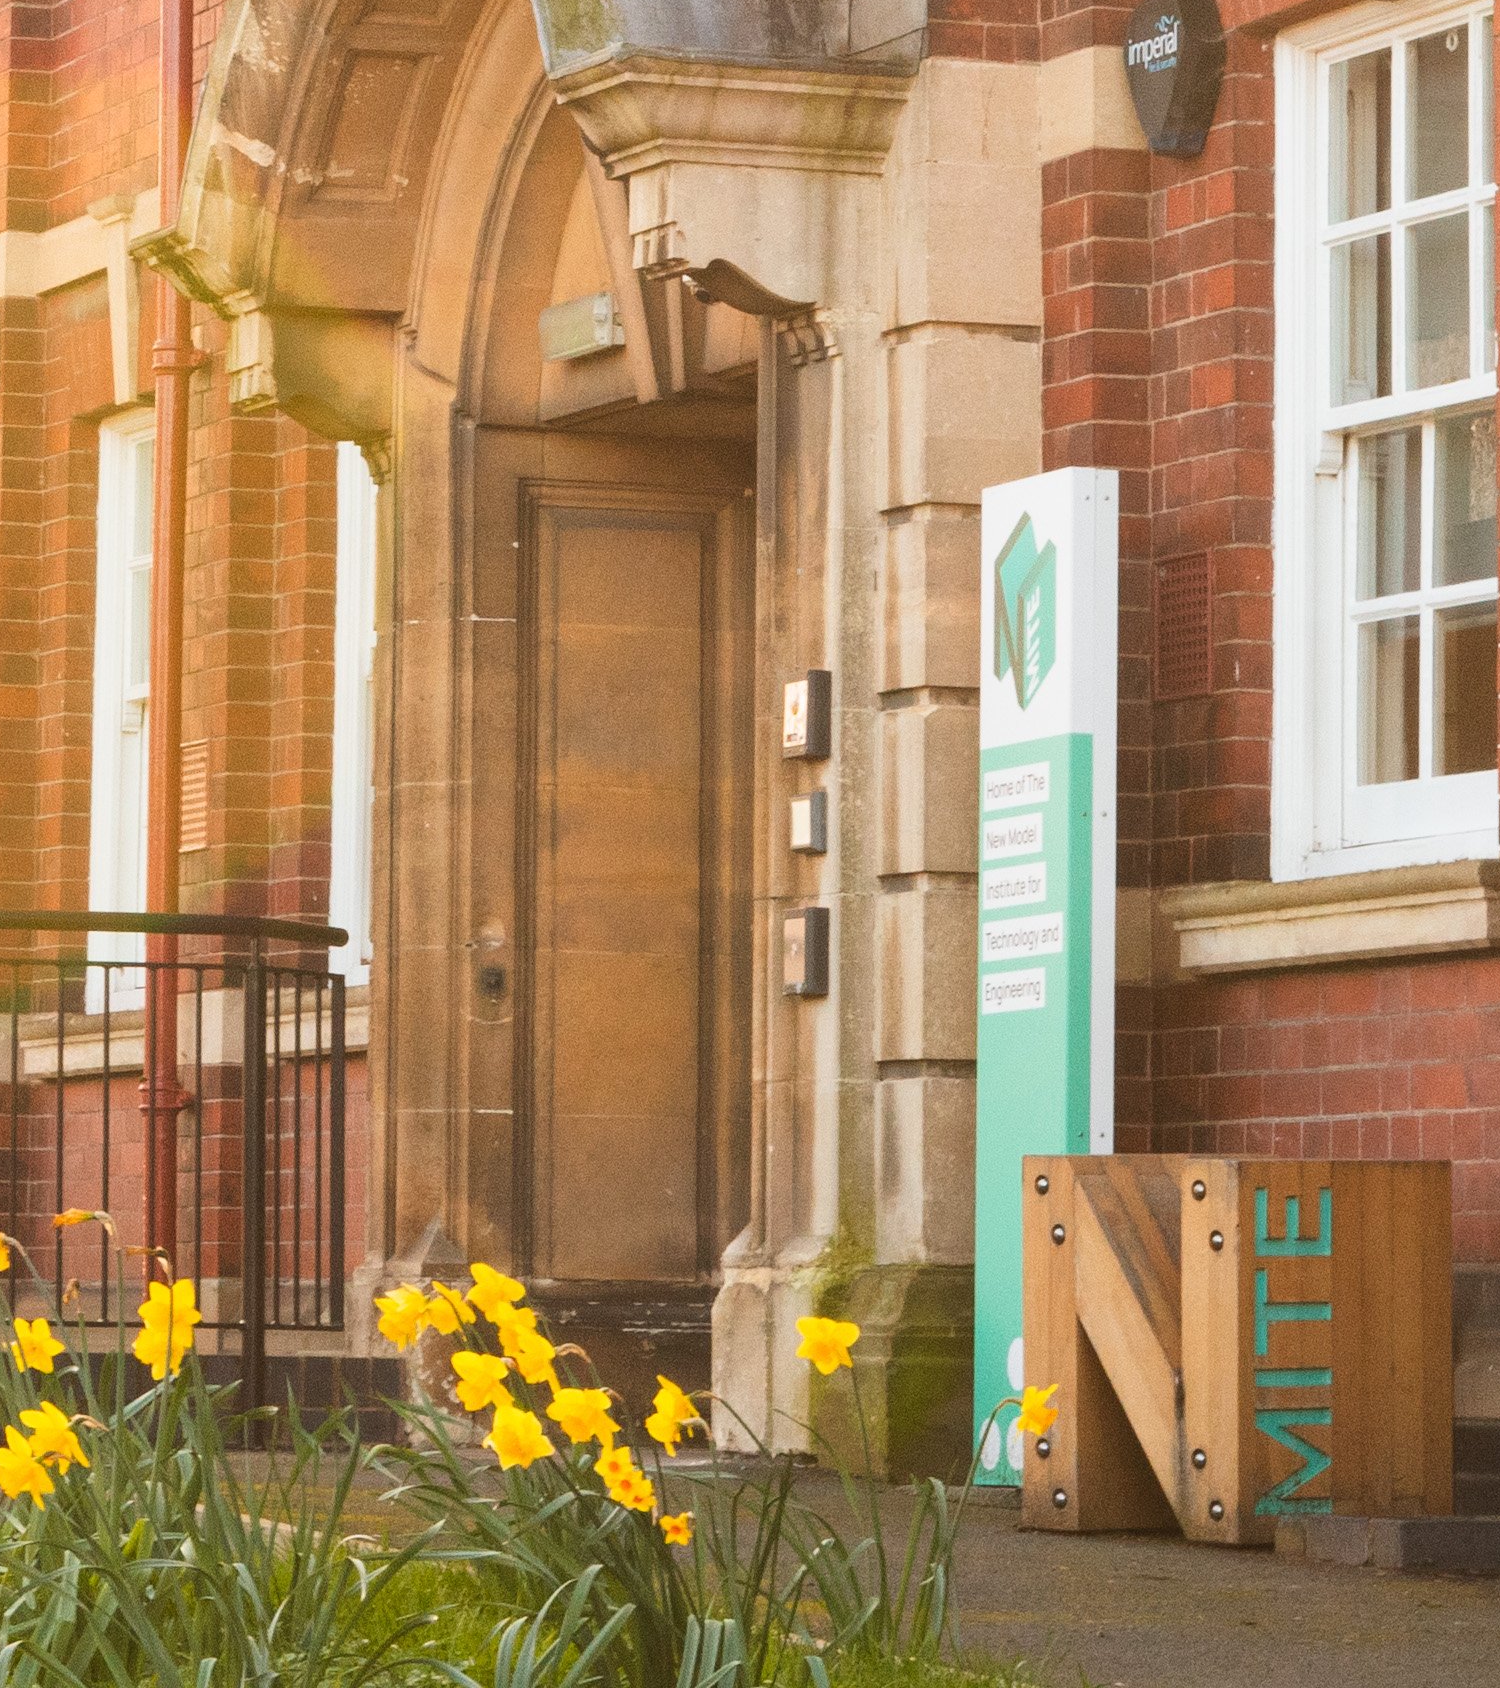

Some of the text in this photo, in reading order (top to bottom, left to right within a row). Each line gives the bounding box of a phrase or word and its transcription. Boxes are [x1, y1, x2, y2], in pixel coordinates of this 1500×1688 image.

[1128, 22, 1177, 70] imperial
[1025, 586, 1041, 702] MITE
[986, 773, 1045, 799] Home of The
[986, 824, 1037, 849] New Model
[986, 875, 1041, 900] Institute for
[985, 923, 1059, 951] Technology and
[985, 978, 1041, 1005] Engineering
[1254, 1187, 1333, 1517] MITE
